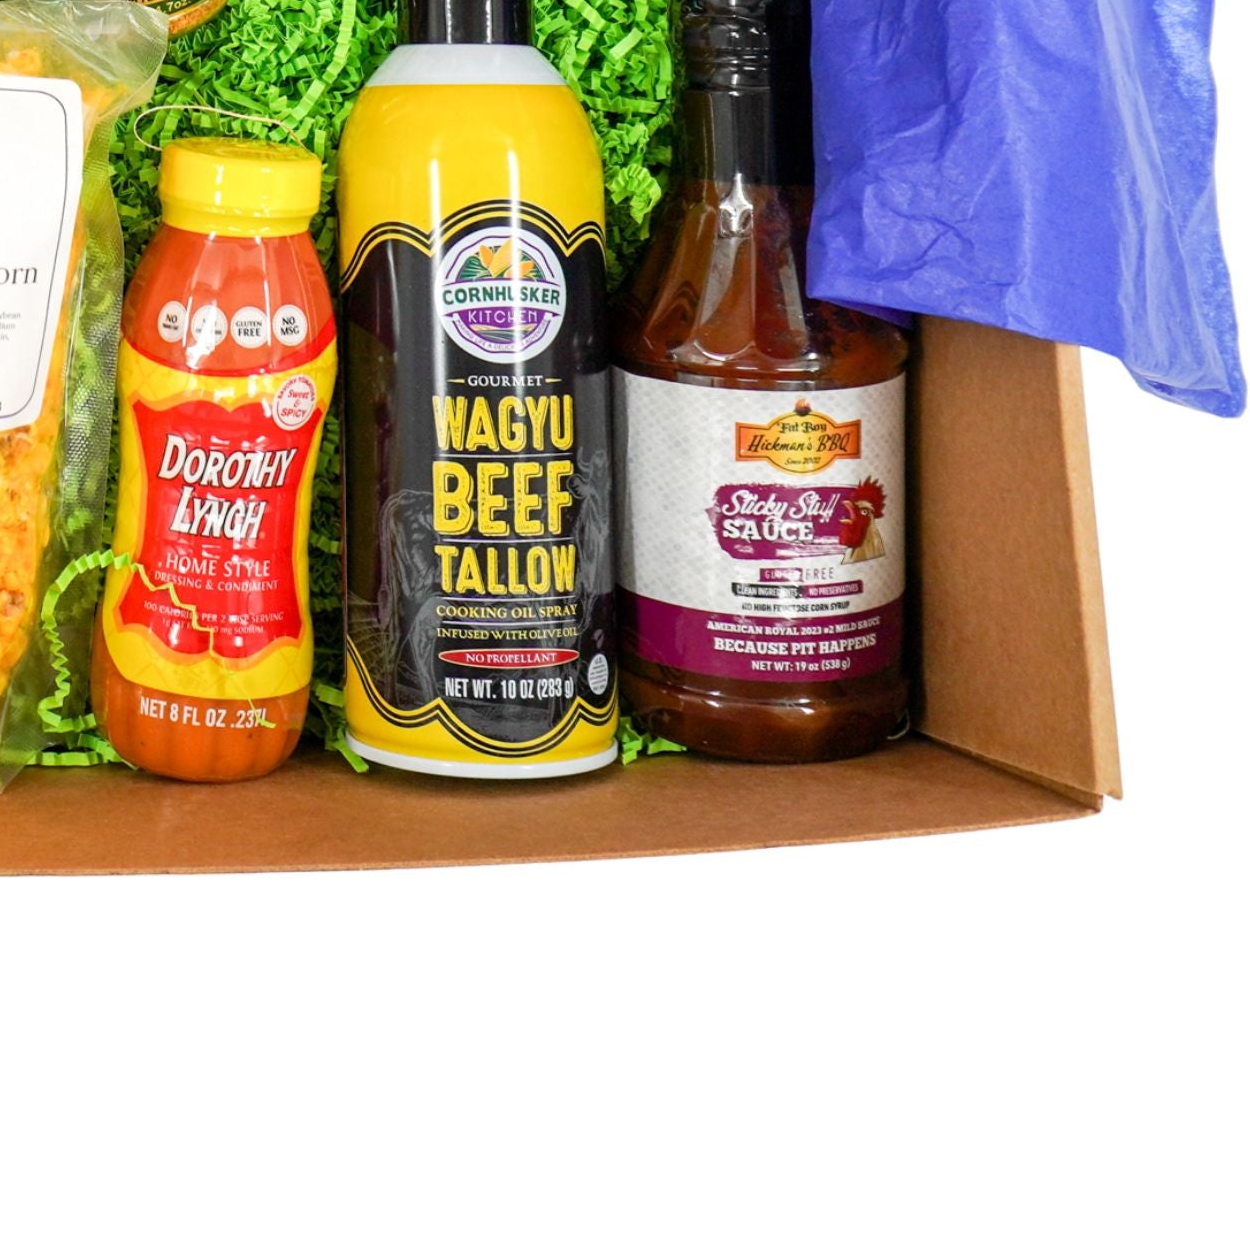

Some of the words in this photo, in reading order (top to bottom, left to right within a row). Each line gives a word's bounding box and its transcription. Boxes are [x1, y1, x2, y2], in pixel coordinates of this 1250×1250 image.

[282, 317, 295, 326] NO
[238, 328, 261, 337] FREE
[280, 326, 300, 336] MSG
[468, 375, 543, 387] GOURMET
[281, 408, 306, 418] SPICY
[432, 394, 574, 452] WAGYU
[748, 434, 813, 452] Hickman's
[816, 433, 850, 452] BBQ
[158, 434, 297, 488] DOROTHY
[432, 460, 574, 537] BEEF
[722, 489, 788, 521] Sticky
[789, 491, 841, 523] Stuff
[723, 519, 814, 541] SAUCE
[166, 553, 217, 576] HOME
[224, 560, 271, 577] STYLE
[434, 544, 576, 595] TALLOW
[805, 567, 834, 580] FREE
[154, 571, 201, 589] DRESSING
[205, 580, 214, 590] &
[218, 580, 279, 591] CONDIMENT
[436, 605, 507, 618] COOKING
[511, 607, 536, 618] OIL
[538, 604, 578, 617] SPRAY
[811, 603, 829, 612] CORN
[830, 601, 850, 611] SYRUP
[202, 613, 217, 622] PER
[221, 614, 225, 623] 2
[251, 612, 283, 622] SERVING
[436, 628, 489, 640] INFUSED
[491, 630, 527, 640] WITH
[529, 628, 562, 640] OLIVE
[563, 627, 578, 636] OIL
[707, 621, 763, 634] AMERICAN
[765, 626, 799, 635] ROYAL
[801, 626, 822, 635] 2023
[836, 622, 856, 633] MILD
[714, 637, 789, 655] BECAUSE
[791, 642, 817, 655] PIT
[819, 633, 877, 654] HAPPENS
[466, 653, 484, 663] NO
[487, 653, 557, 663] PROPELLANT
[752, 660, 772, 671] NET
[774, 661, 793, 671] WT:
[795, 661, 806, 671] 19
[808, 663, 819, 671] oz
[821, 660, 840, 671] (538
[841, 657, 850, 670] g)
[445, 677, 469, 698] NET
[472, 678, 497, 699] WT.
[501, 680, 516, 699] 10
[520, 679, 534, 699] OZ
[536, 677, 562, 700] (283
[565, 676, 574, 698] g)
[140, 697, 166, 719] NET
[170, 704, 178, 722] 8
[182, 706, 200, 725] FL
[205, 709, 227, 728] OZ
